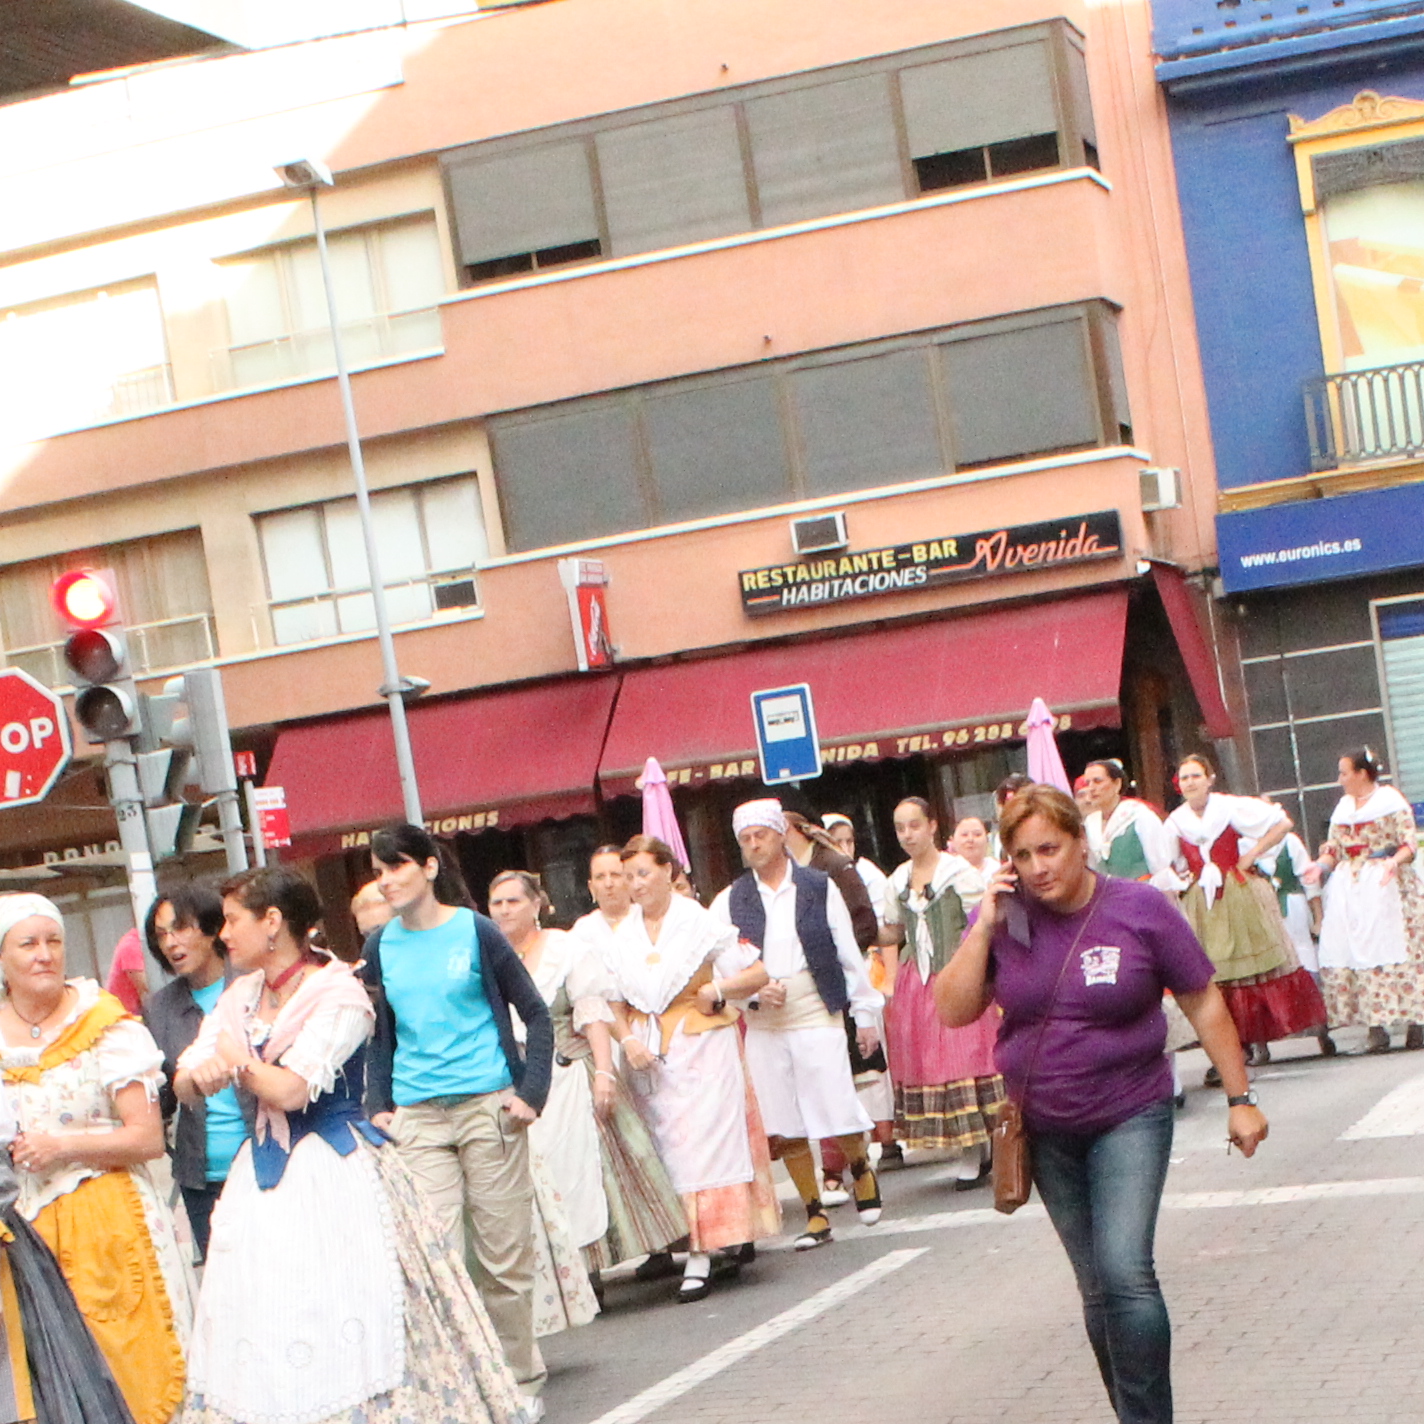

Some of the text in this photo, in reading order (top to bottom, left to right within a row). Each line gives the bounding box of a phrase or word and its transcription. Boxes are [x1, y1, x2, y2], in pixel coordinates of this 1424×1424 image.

[966, 521, 1118, 572] Avenida
[1240, 538, 1362, 568] www.euronics.es
[782, 565, 928, 606] HABITACIONES
[709, 760, 756, 780] BAR
[820, 742, 879, 763] NIDA
[942, 728, 970, 747] 96
